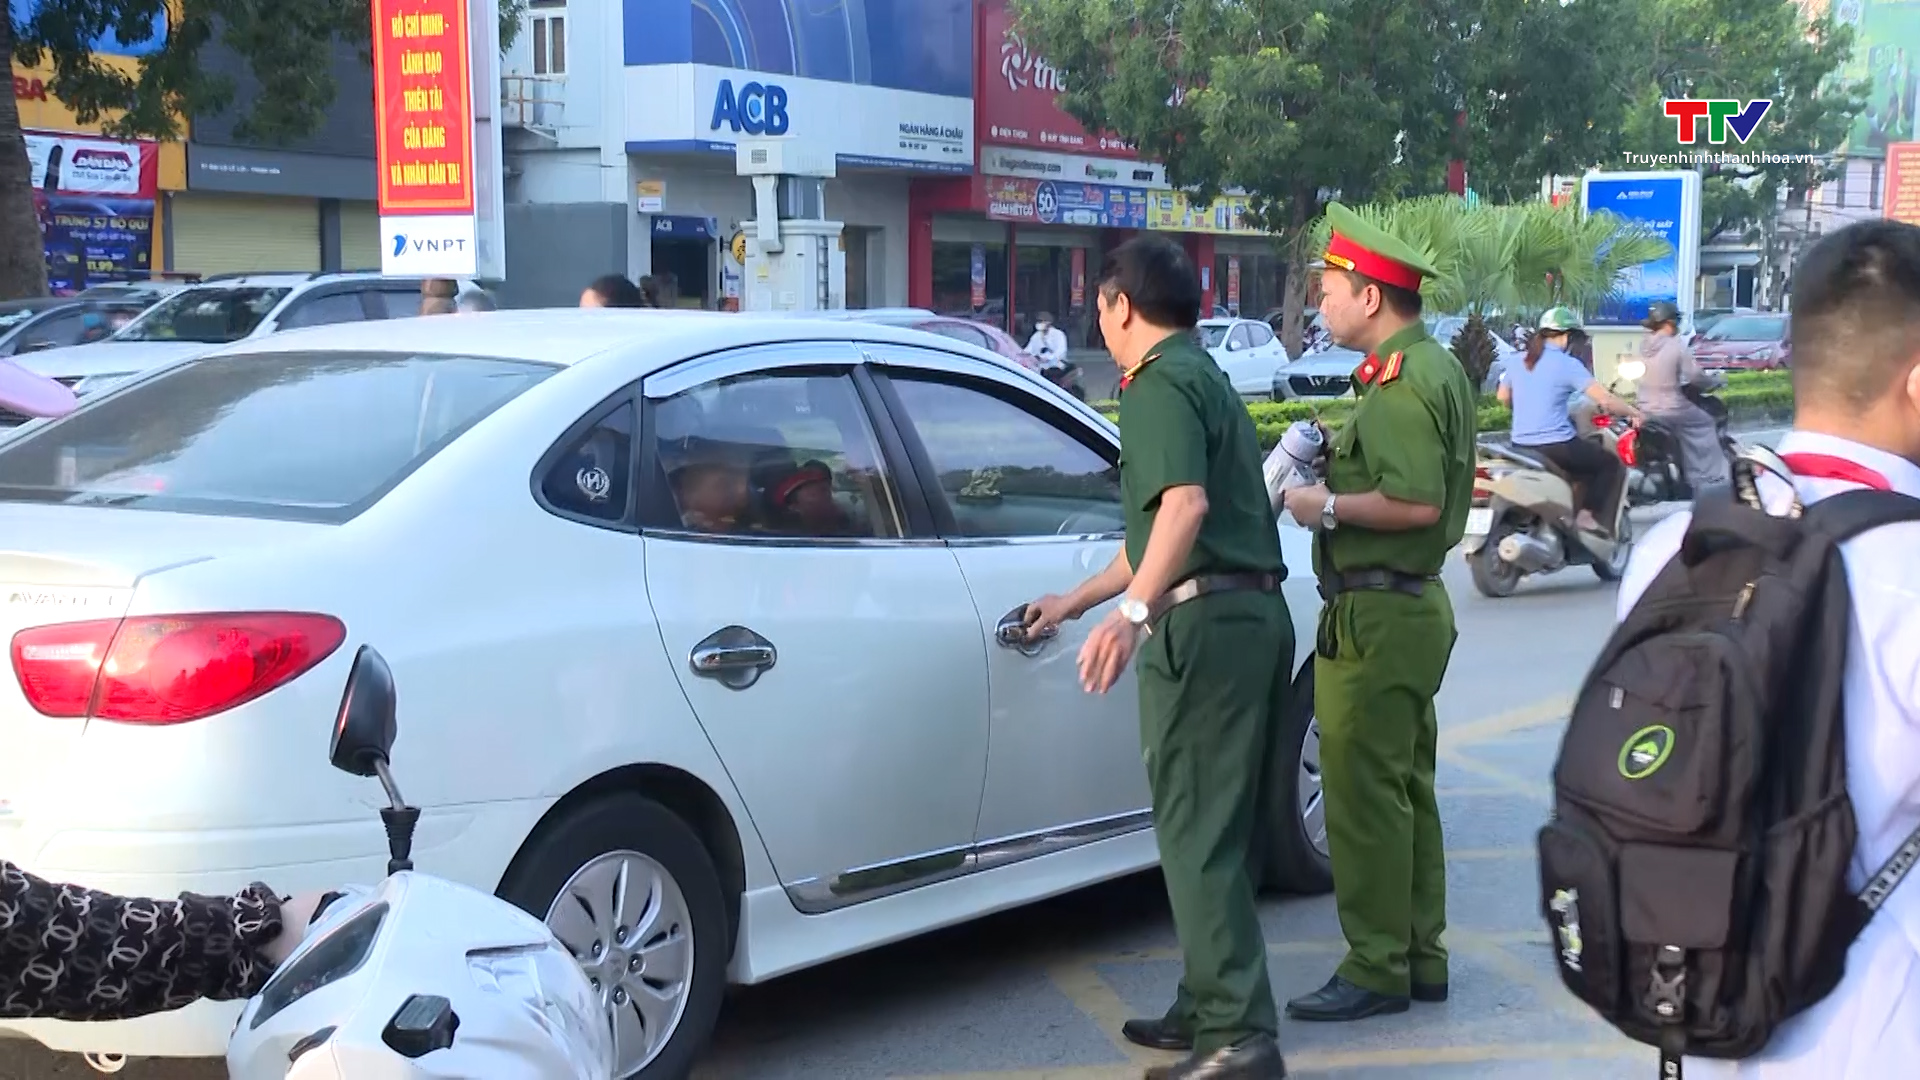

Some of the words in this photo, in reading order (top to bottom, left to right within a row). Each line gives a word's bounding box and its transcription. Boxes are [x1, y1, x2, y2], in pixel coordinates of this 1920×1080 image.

[391, 9, 403, 38] HỒ
[405, 10, 419, 38] CHÍ
[421, 12, 444, 36] MINH
[401, 49, 424, 75] LÃNH
[425, 51, 442, 78] ĐẠO
[404, 86, 428, 112] THIÊN
[429, 84, 443, 111] TÀI
[711, 79, 789, 136] ACB
[404, 120, 421, 149] CỦA
[422, 120, 446, 148] ĐẢNG
[391, 160, 402, 186] VÀ
[403, 160, 427, 187] NHÂN
[428, 160, 446, 186] DÂN
[447, 162, 460, 185] TA!
[413, 239, 466, 252] VNPT
